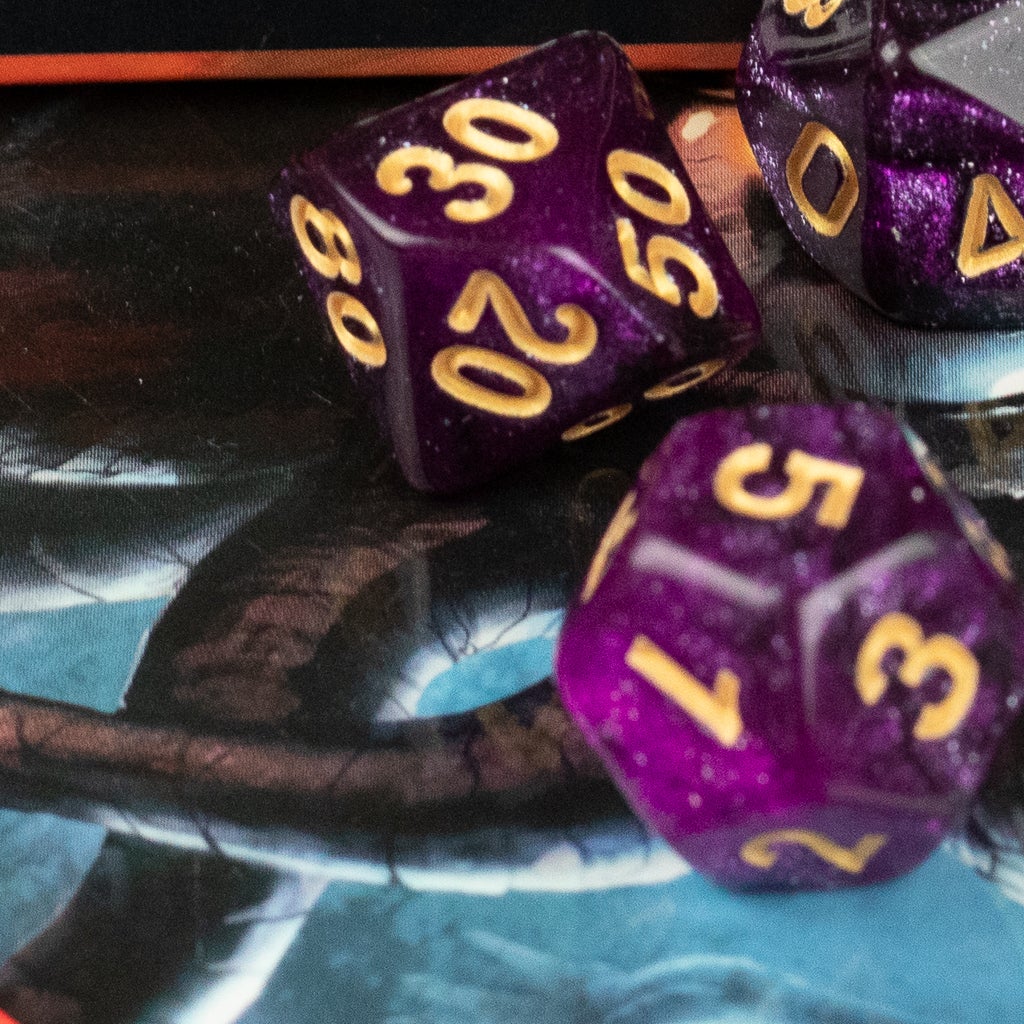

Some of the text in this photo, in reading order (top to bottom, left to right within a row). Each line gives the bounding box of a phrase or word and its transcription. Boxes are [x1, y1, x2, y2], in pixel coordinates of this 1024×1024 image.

[376, 98, 559, 223] 30
[786, 122, 859, 237] 0
[290, 195, 387, 367] 80
[607, 149, 719, 319] 50
[431, 272, 597, 419] 20
[713, 442, 865, 529] 5
[626, 635, 743, 748] 1
[854, 612, 980, 741] 3
